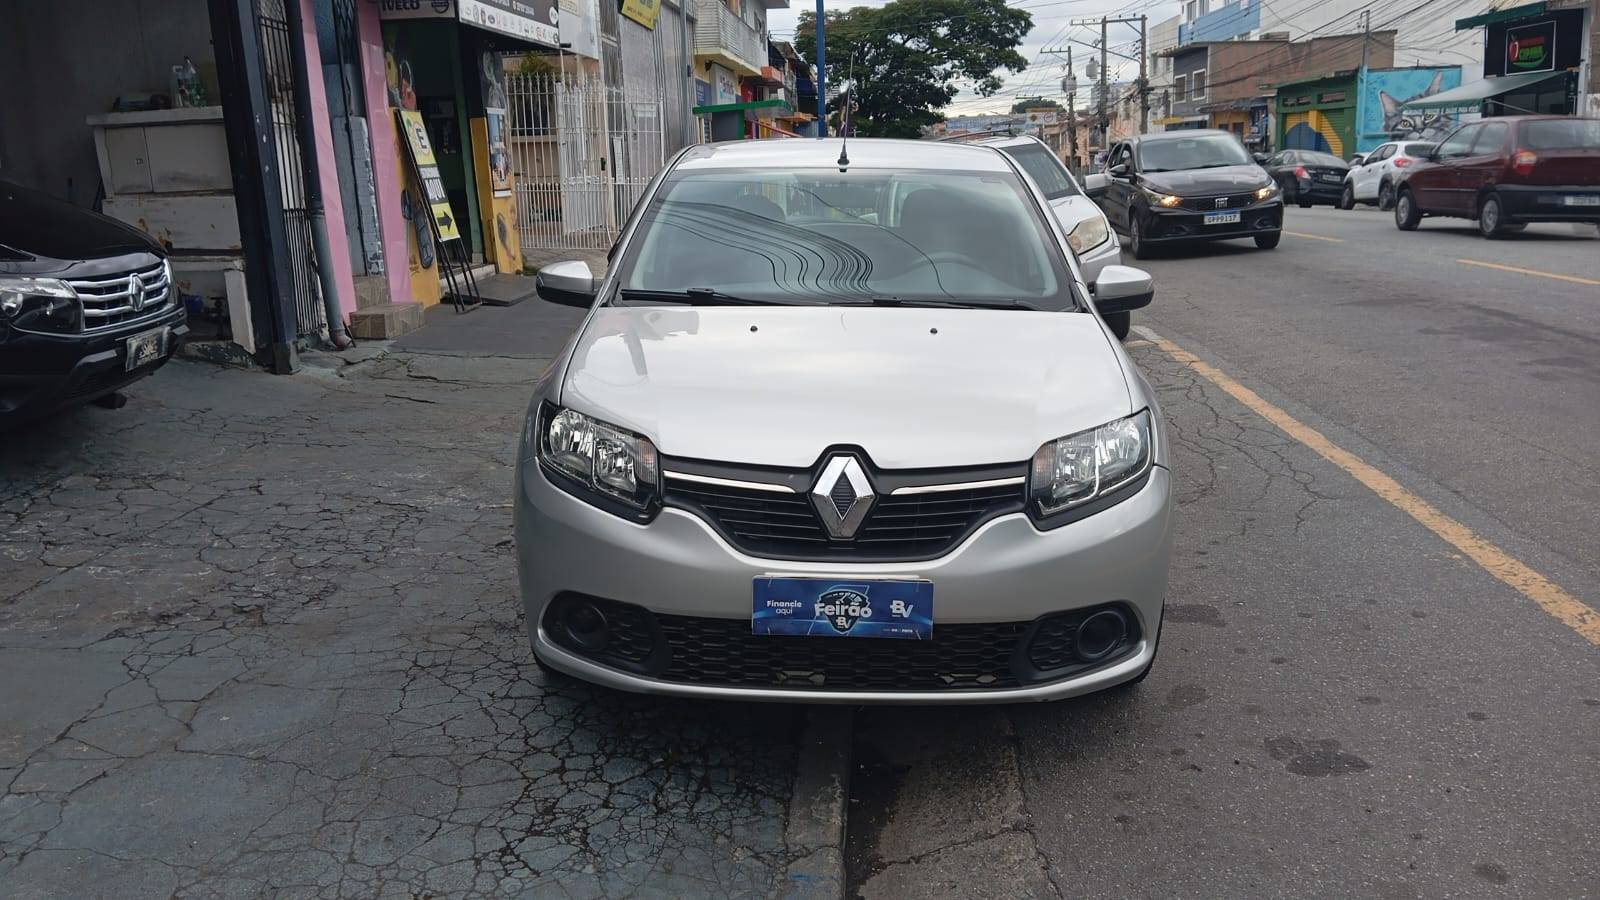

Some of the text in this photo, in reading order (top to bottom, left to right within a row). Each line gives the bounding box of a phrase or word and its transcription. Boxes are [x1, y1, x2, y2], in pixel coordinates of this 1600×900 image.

[766, 600, 802, 608] Financie
[775, 607, 793, 615] aqui
[814, 600, 872, 618] Feirão
